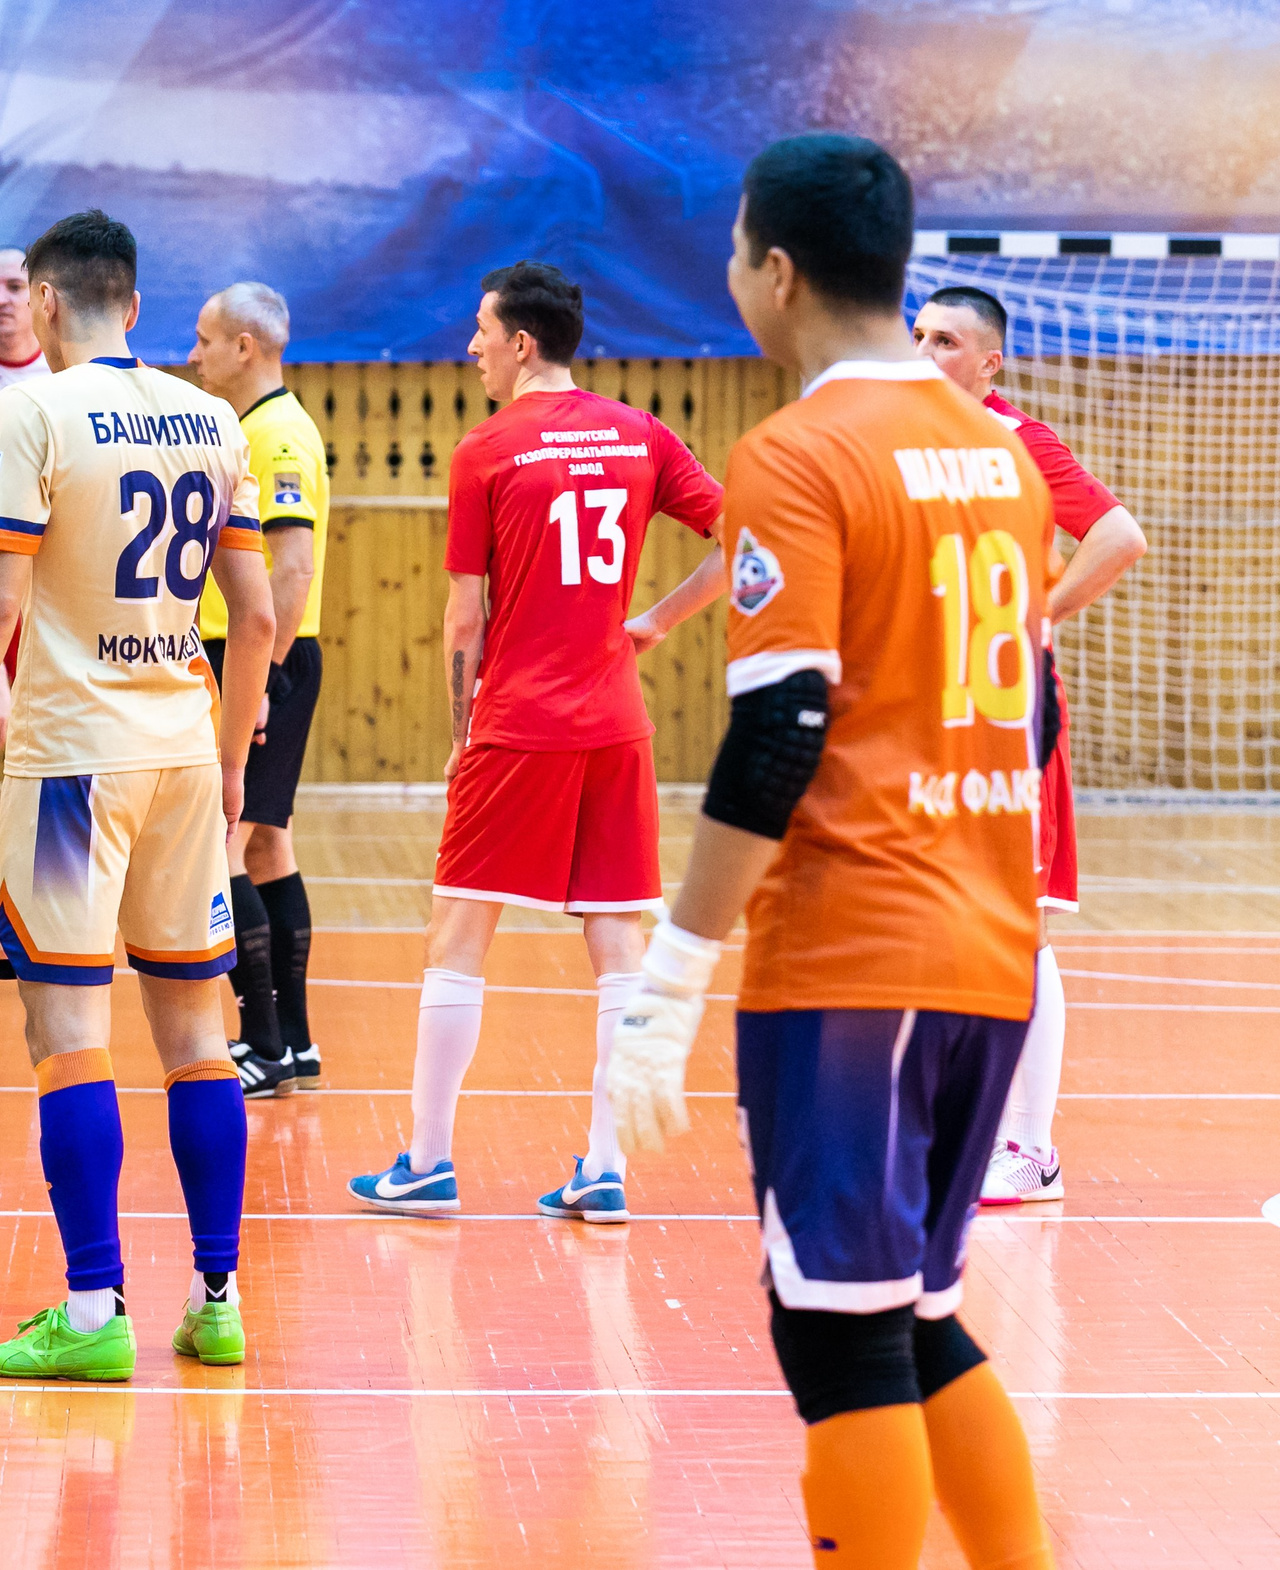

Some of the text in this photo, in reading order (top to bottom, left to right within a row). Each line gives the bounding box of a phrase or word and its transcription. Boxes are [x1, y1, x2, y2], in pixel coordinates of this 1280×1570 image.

[87, 411, 222, 447] БАШИЛИН
[540, 427, 620, 443] ОРЕНБУРГСКИЙ
[513, 442, 648, 467] ГАЗОПЕРЕРАБАТЫВАЮЩИЙ
[568, 462, 605, 476] ЗАВОД
[114, 469, 218, 603] 28
[549, 488, 628, 586] 13
[928, 528, 1037, 730] 18
[98, 633, 159, 664] МФК
